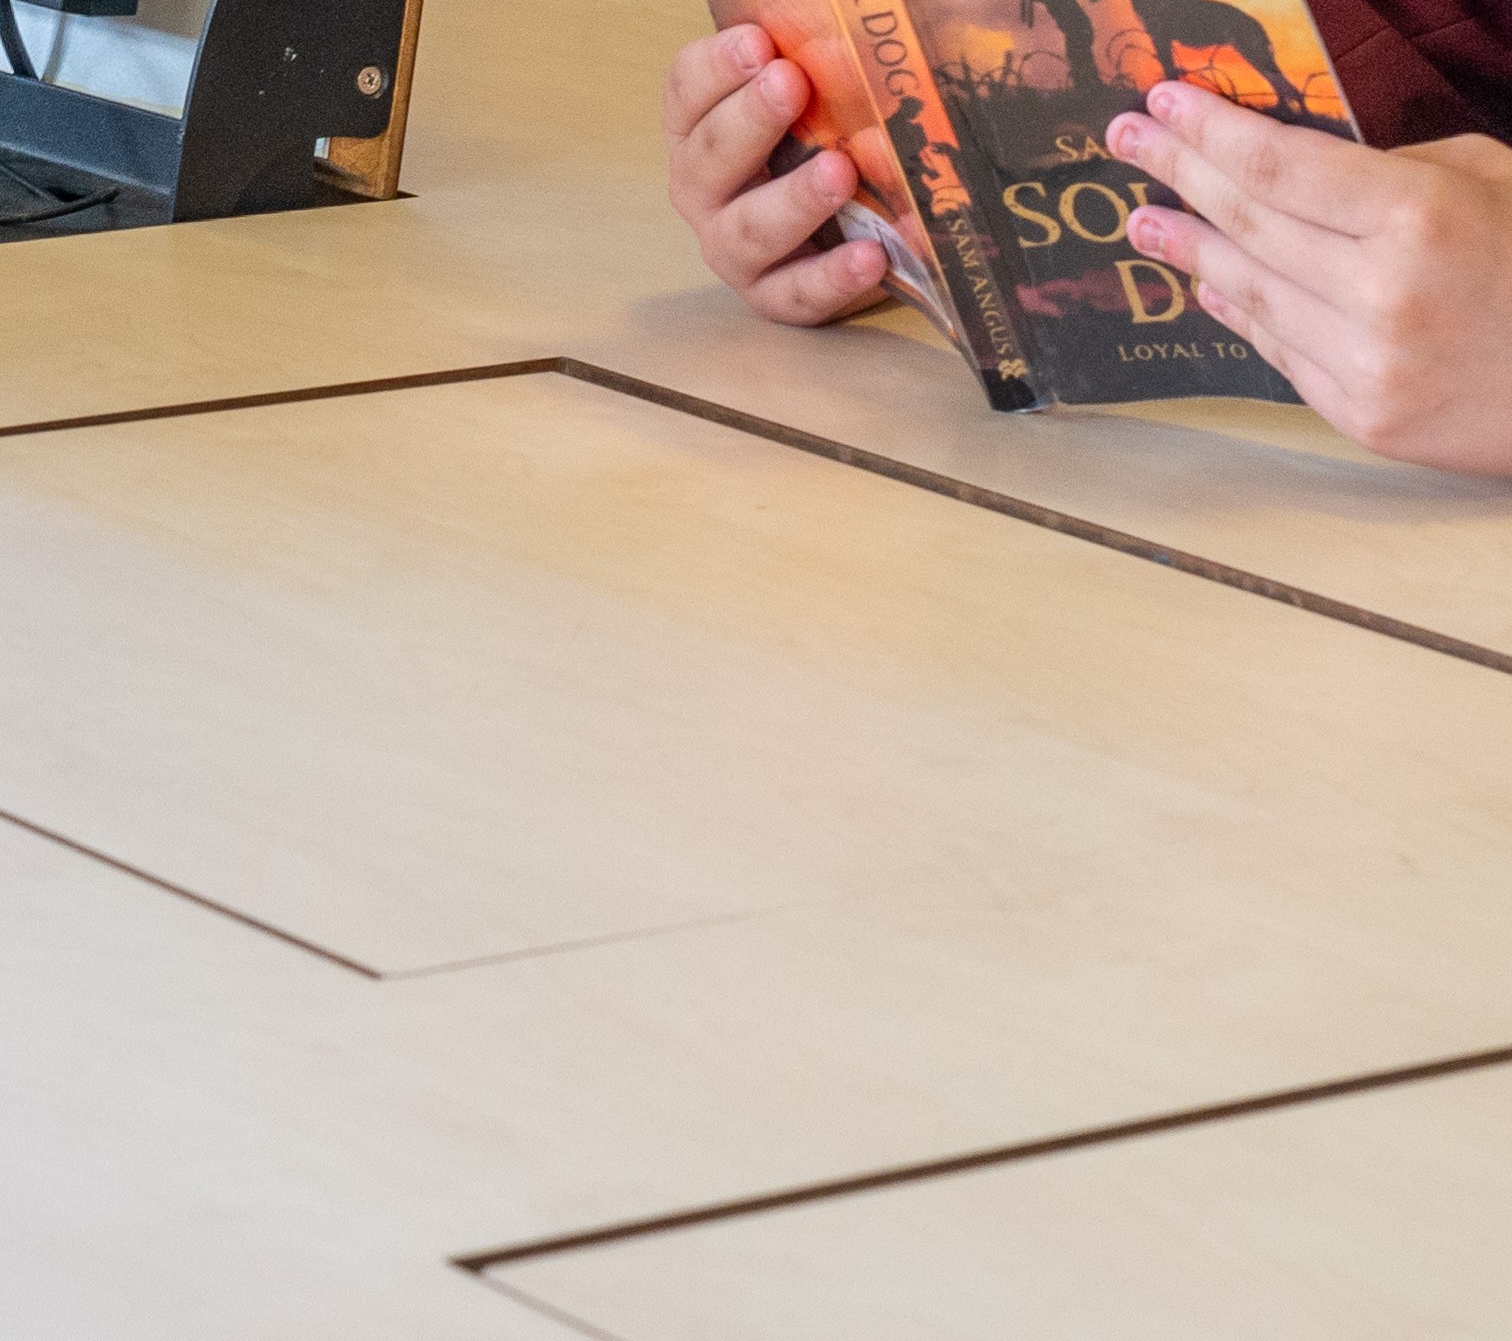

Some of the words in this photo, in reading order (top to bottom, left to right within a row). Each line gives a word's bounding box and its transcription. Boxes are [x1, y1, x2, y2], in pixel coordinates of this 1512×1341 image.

[861, 10, 920, 97] DOG
[1055, 135, 1111, 162] SA
[950, 217, 981, 270] SAM
[970, 274, 1013, 356] ANGUS
[1118, 342, 1204, 364] LOYAL
[1212, 341, 1249, 360] TO
